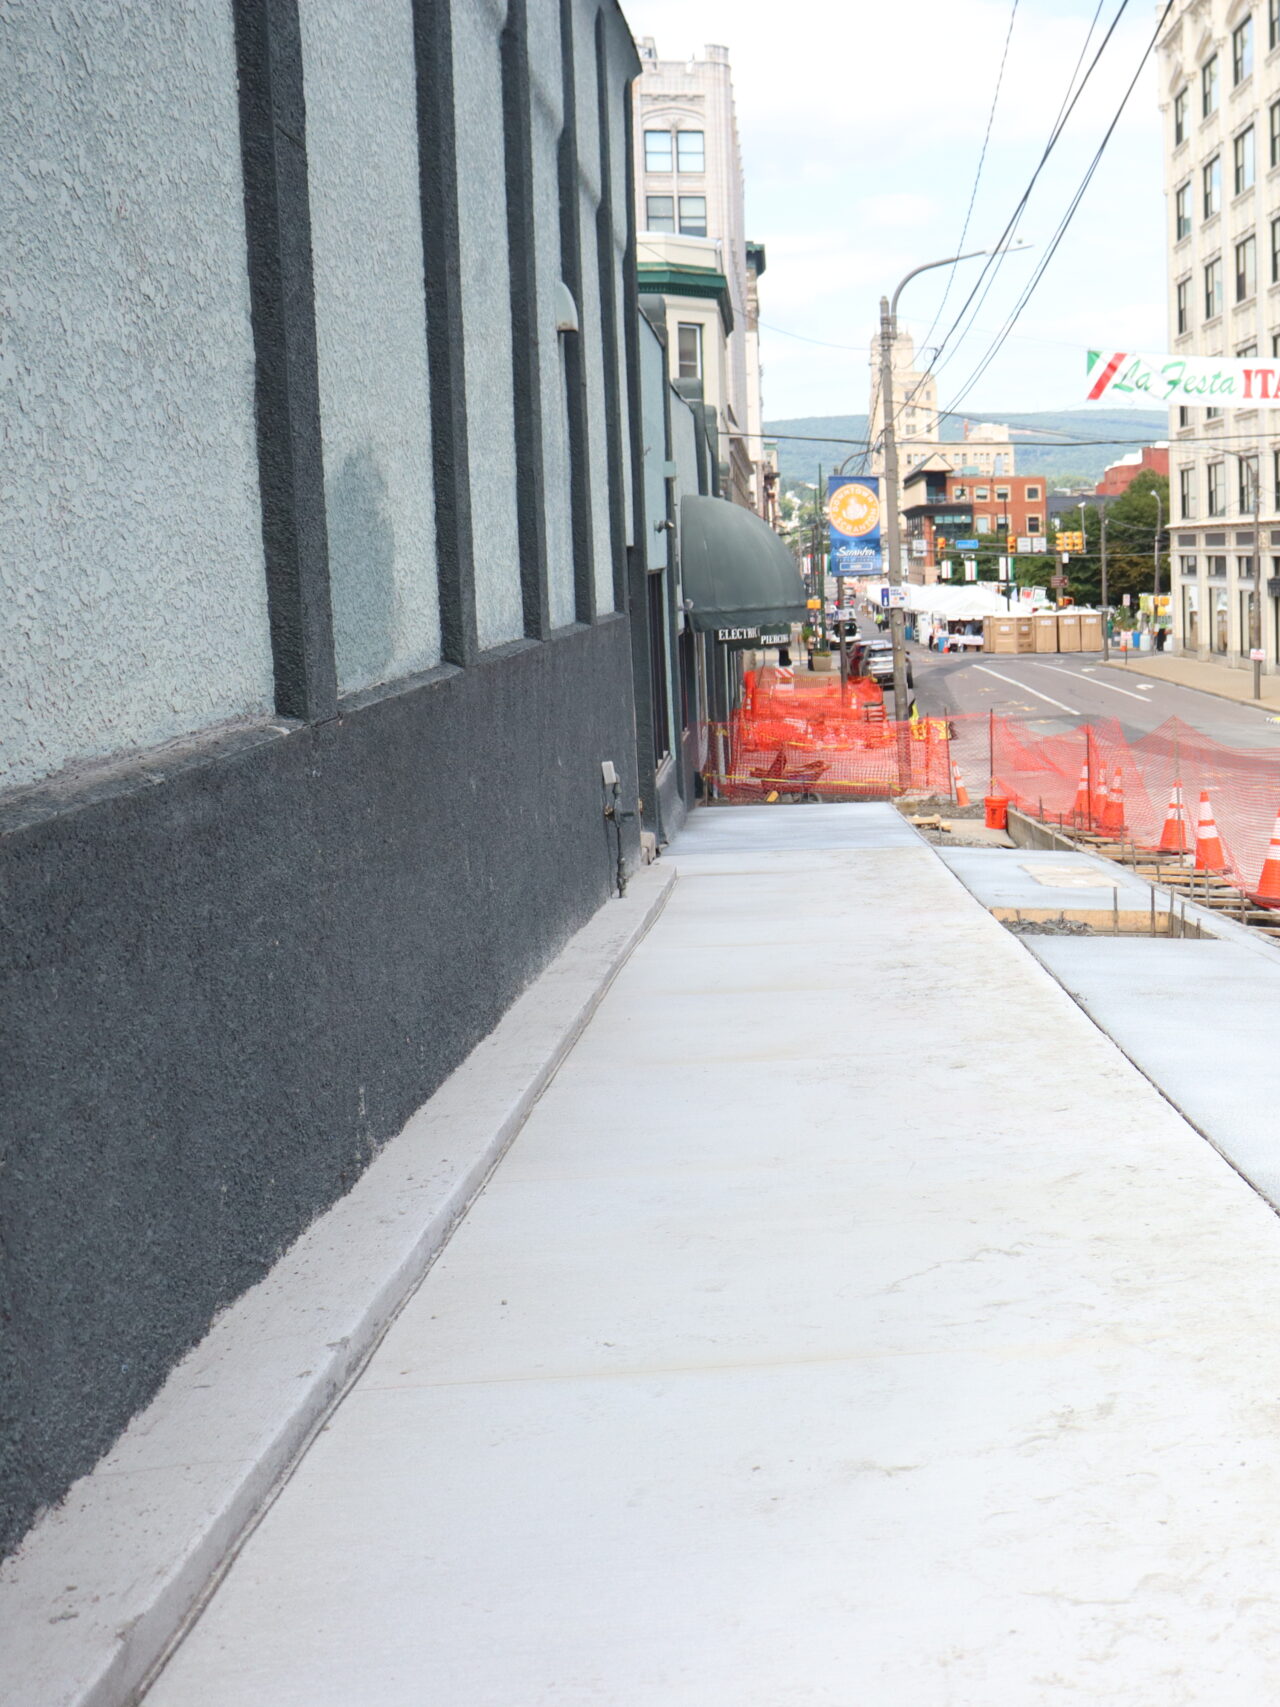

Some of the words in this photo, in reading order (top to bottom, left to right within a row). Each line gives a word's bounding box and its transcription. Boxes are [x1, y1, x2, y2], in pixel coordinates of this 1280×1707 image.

[1113, 359, 1151, 393] La
[1159, 361, 1236, 399] Festa
[832, 487, 874, 512] DOWNTOWN
[834, 507, 877, 533] SCRANTON
